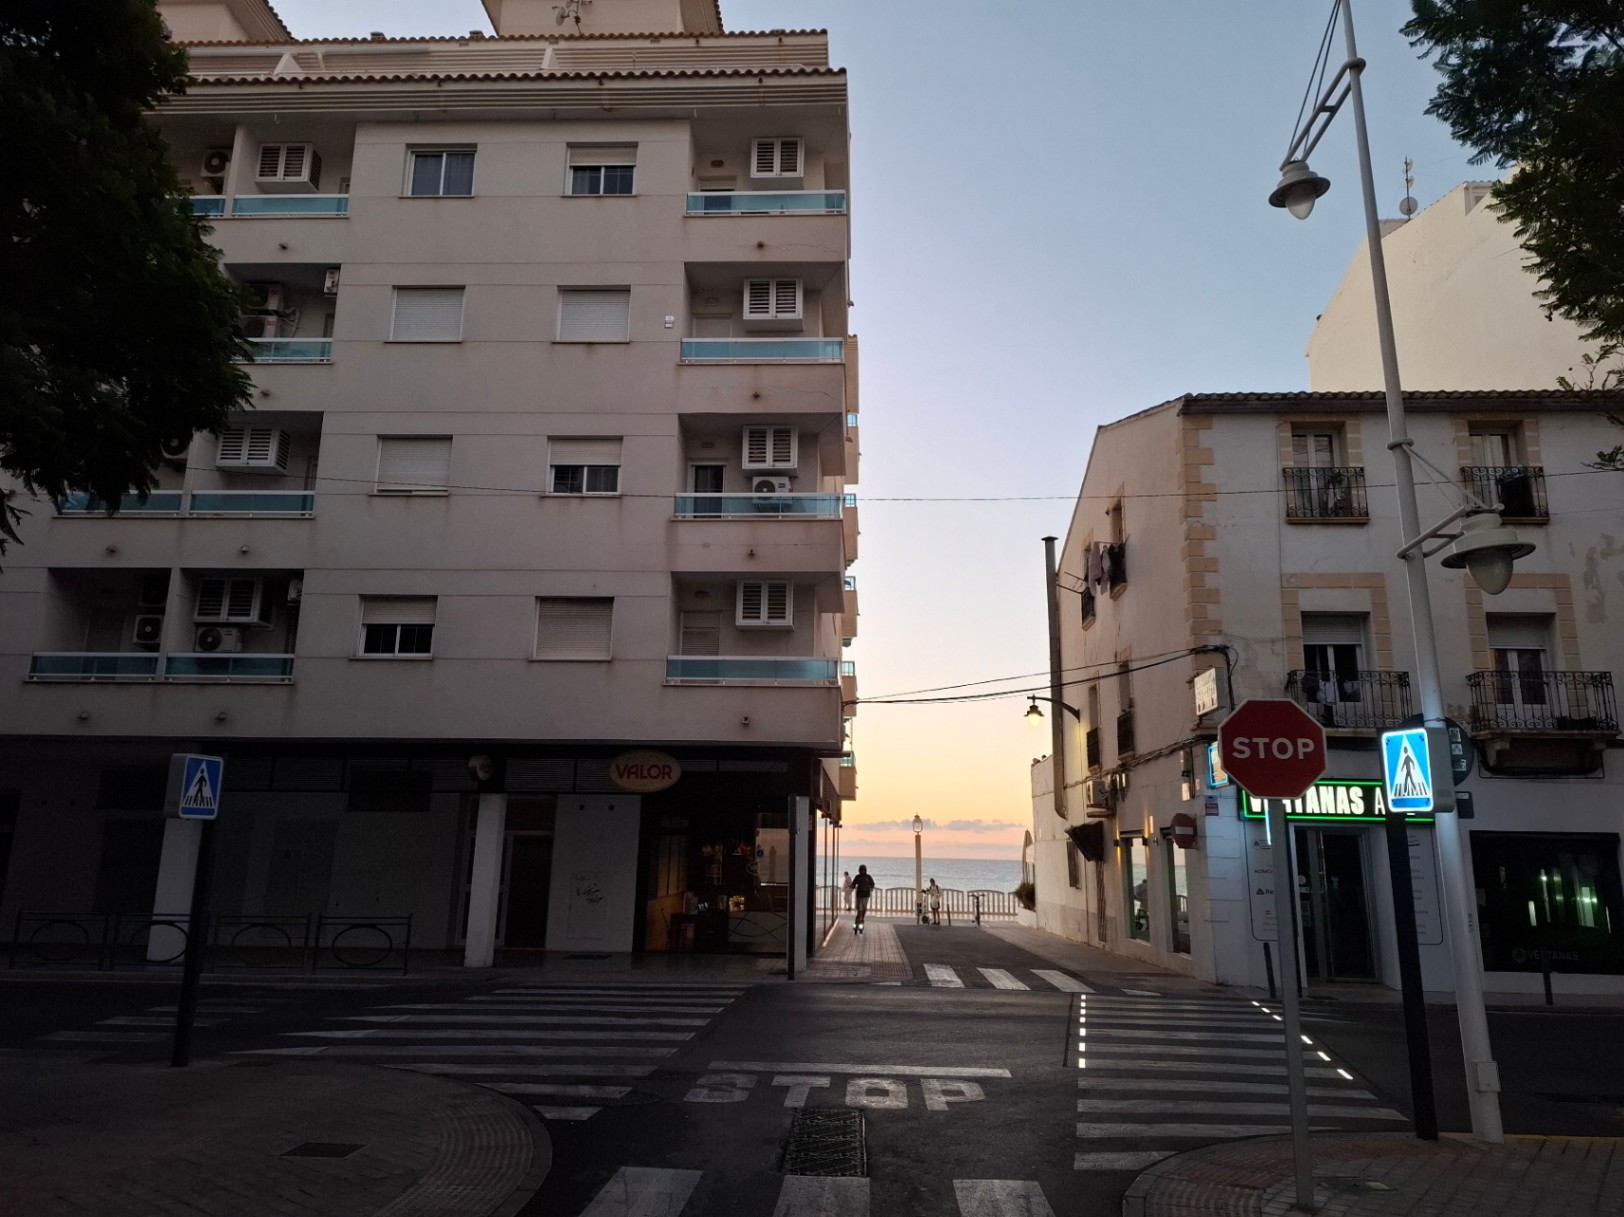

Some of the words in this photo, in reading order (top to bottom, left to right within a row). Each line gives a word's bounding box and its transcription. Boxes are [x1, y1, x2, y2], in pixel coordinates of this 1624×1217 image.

[1232, 737, 1315, 759] STOP
[615, 764, 672, 779] VALOR
[1250, 785, 1365, 815] VANAS
[1527, 950, 1579, 960] VETANAS
[683, 1073, 986, 1111] STOP
